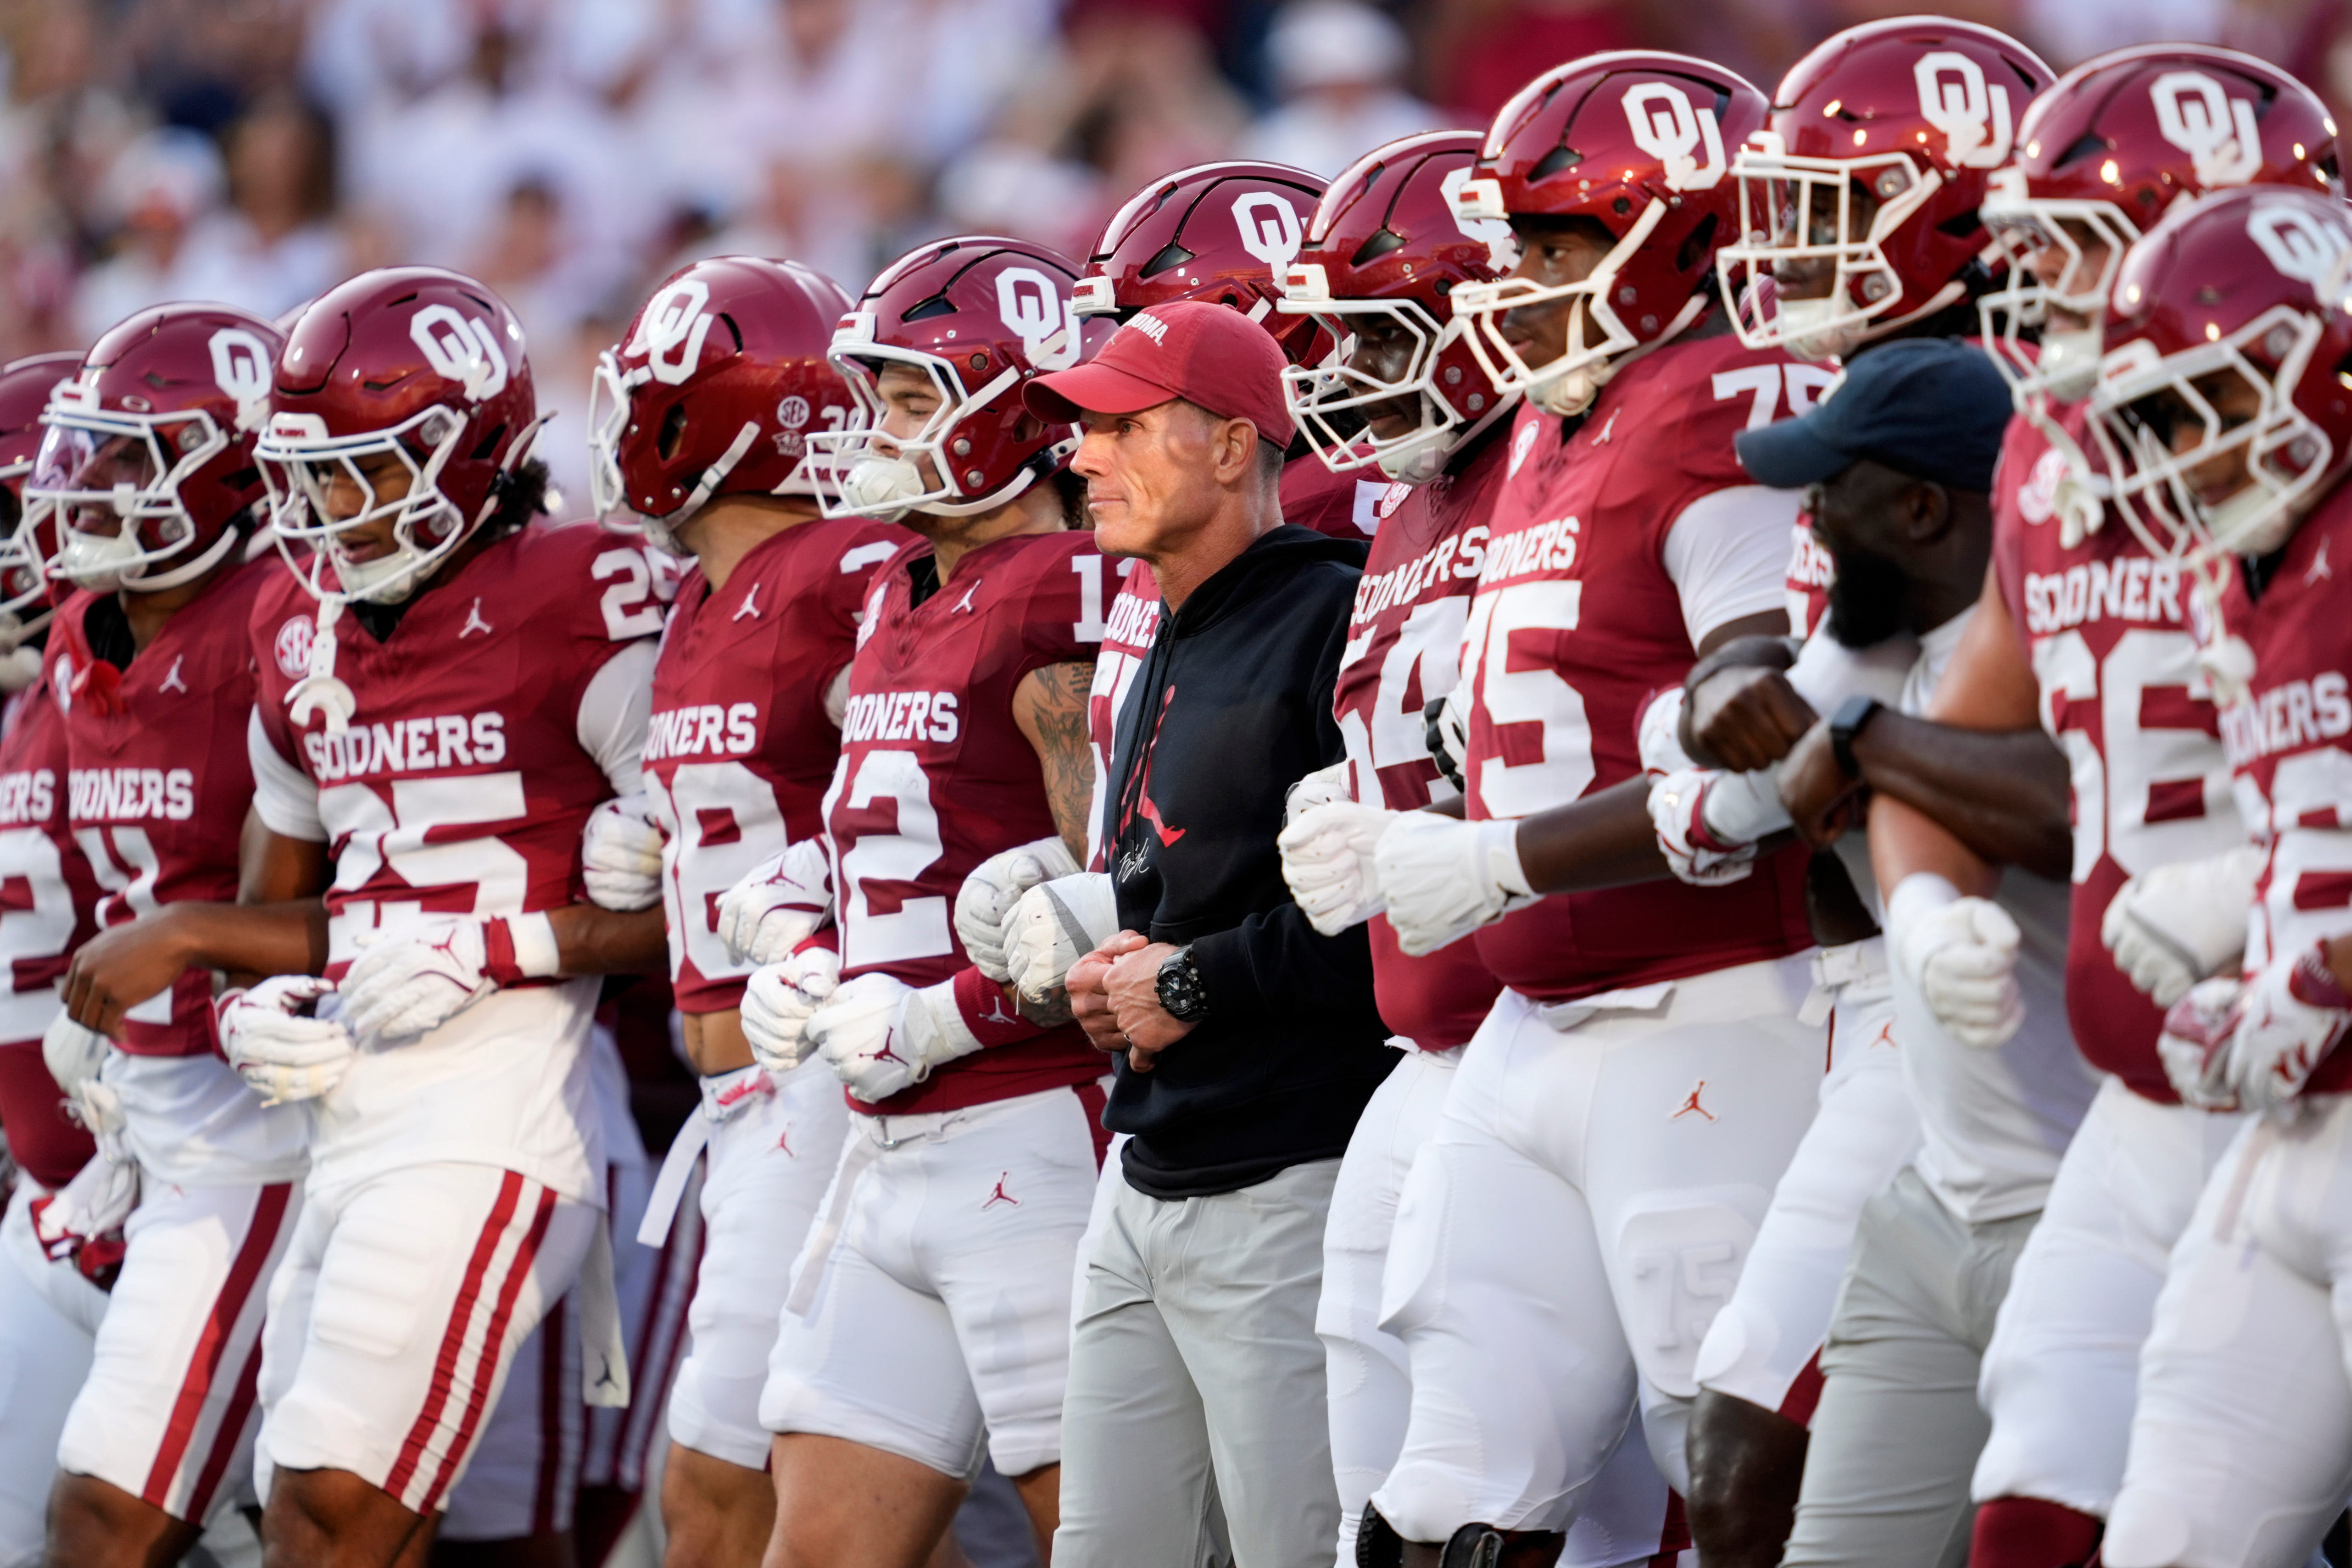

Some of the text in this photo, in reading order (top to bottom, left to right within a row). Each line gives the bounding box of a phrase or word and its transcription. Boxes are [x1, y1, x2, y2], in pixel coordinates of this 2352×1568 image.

[1621, 82, 1727, 191] OU
[1913, 52, 2013, 168] OU
[2149, 71, 2263, 186] OU
[409, 303, 508, 401] OU
[646, 278, 714, 386] OU
[995, 266, 1081, 371] OU
[1349, 525, 1490, 628] SOONERS
[2024, 556, 2185, 634] SOONER
[304, 712, 506, 781] SOONERS
